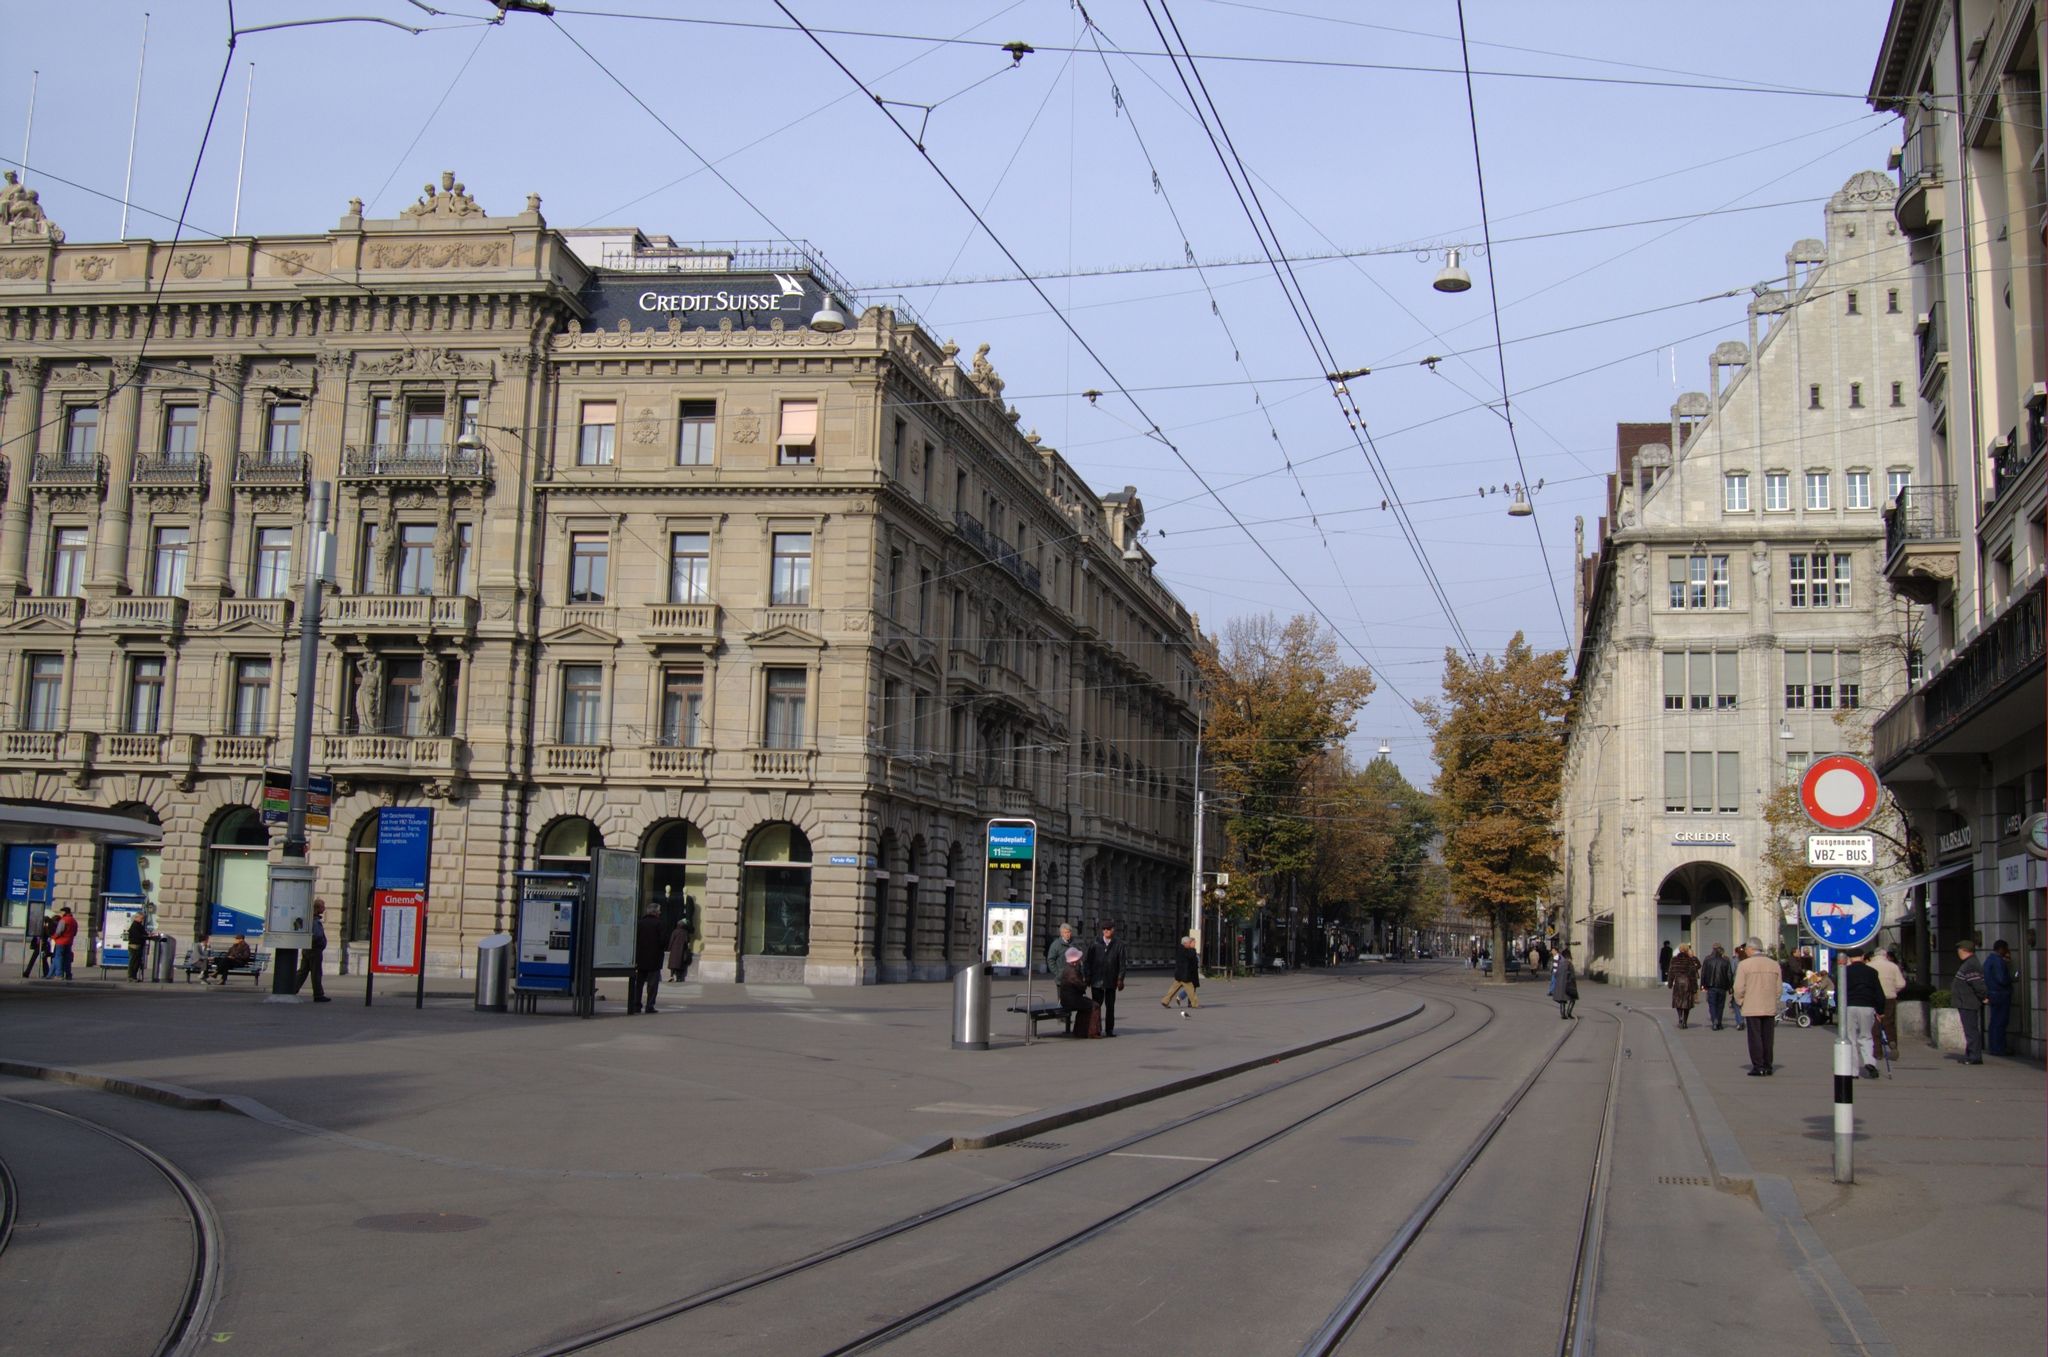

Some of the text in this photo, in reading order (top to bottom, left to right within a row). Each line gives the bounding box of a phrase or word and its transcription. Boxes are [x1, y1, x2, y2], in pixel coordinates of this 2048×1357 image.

[639, 291, 782, 311] CREDIT SUISSE
[990, 836, 1027, 844] Paradeplatz
[1674, 831, 1731, 841] GRIEDER
[1816, 839, 1866, 847] ausgenommen
[993, 848, 1001, 856] 11
[1814, 849, 1836, 861] VBZ
[1846, 849, 1867, 861] BUS
[384, 895, 415, 904] Cinema
